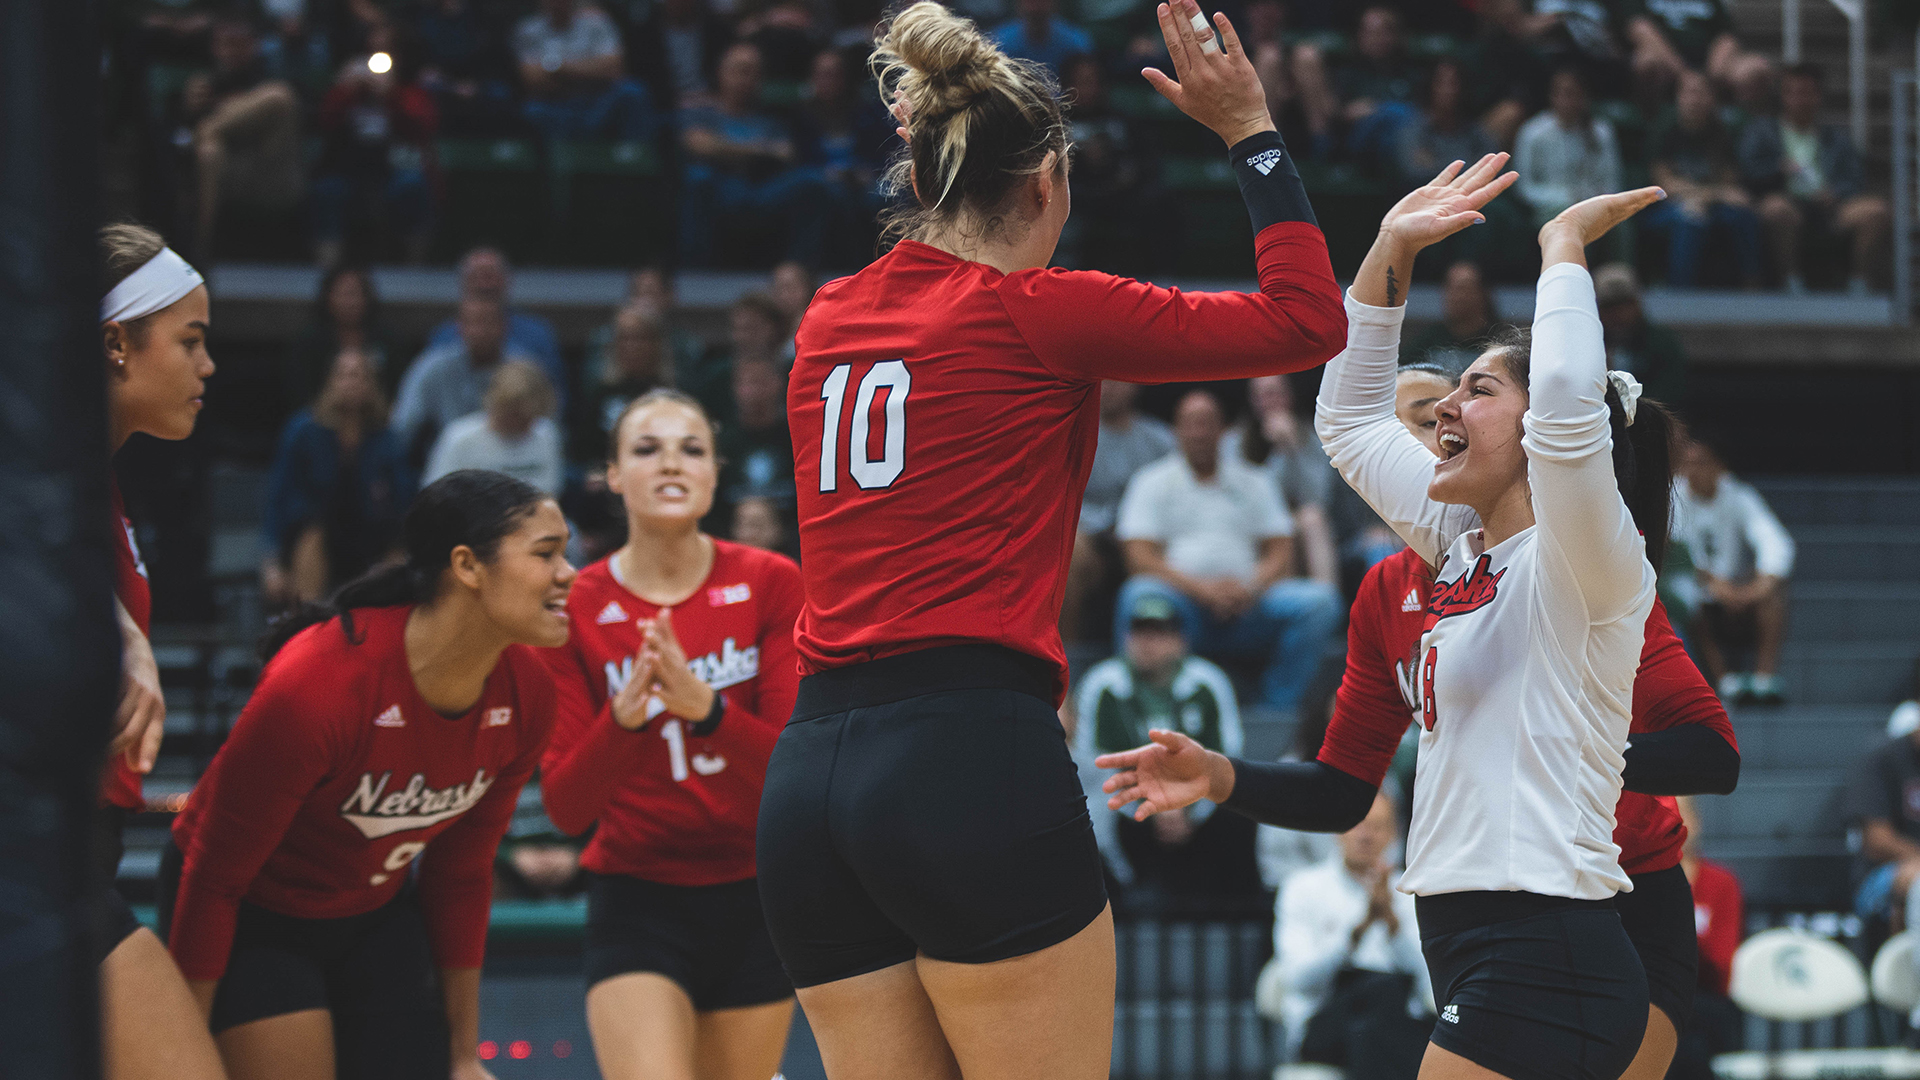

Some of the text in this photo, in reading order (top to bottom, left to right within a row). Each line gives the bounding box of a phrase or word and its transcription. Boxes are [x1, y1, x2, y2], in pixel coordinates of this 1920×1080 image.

[1246, 149, 1281, 166] adidas
[819, 358, 912, 494] 10
[1423, 646, 1437, 732] 8
